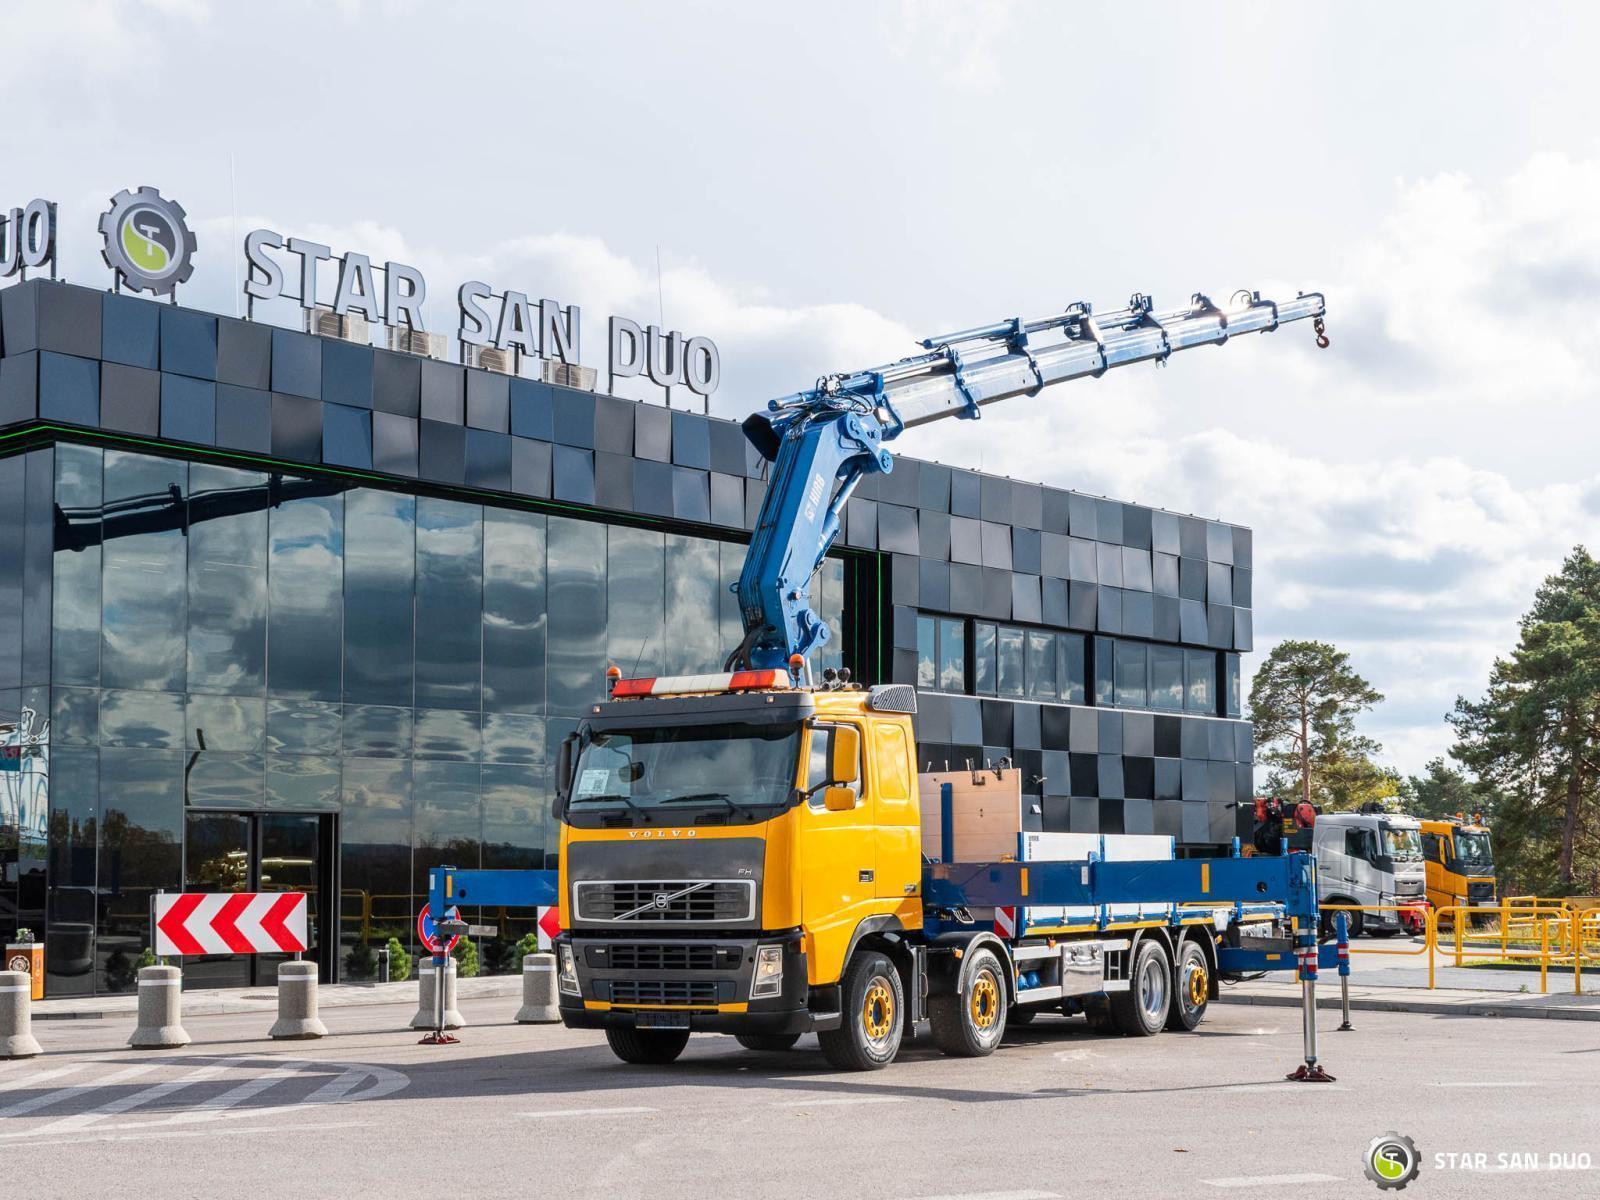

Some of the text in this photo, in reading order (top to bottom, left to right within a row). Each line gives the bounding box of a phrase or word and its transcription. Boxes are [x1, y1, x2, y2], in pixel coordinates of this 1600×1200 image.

[244, 229, 720, 396] STAR SAN DUO
[629, 829, 696, 839] VOLVO
[737, 867, 753, 876] FH
